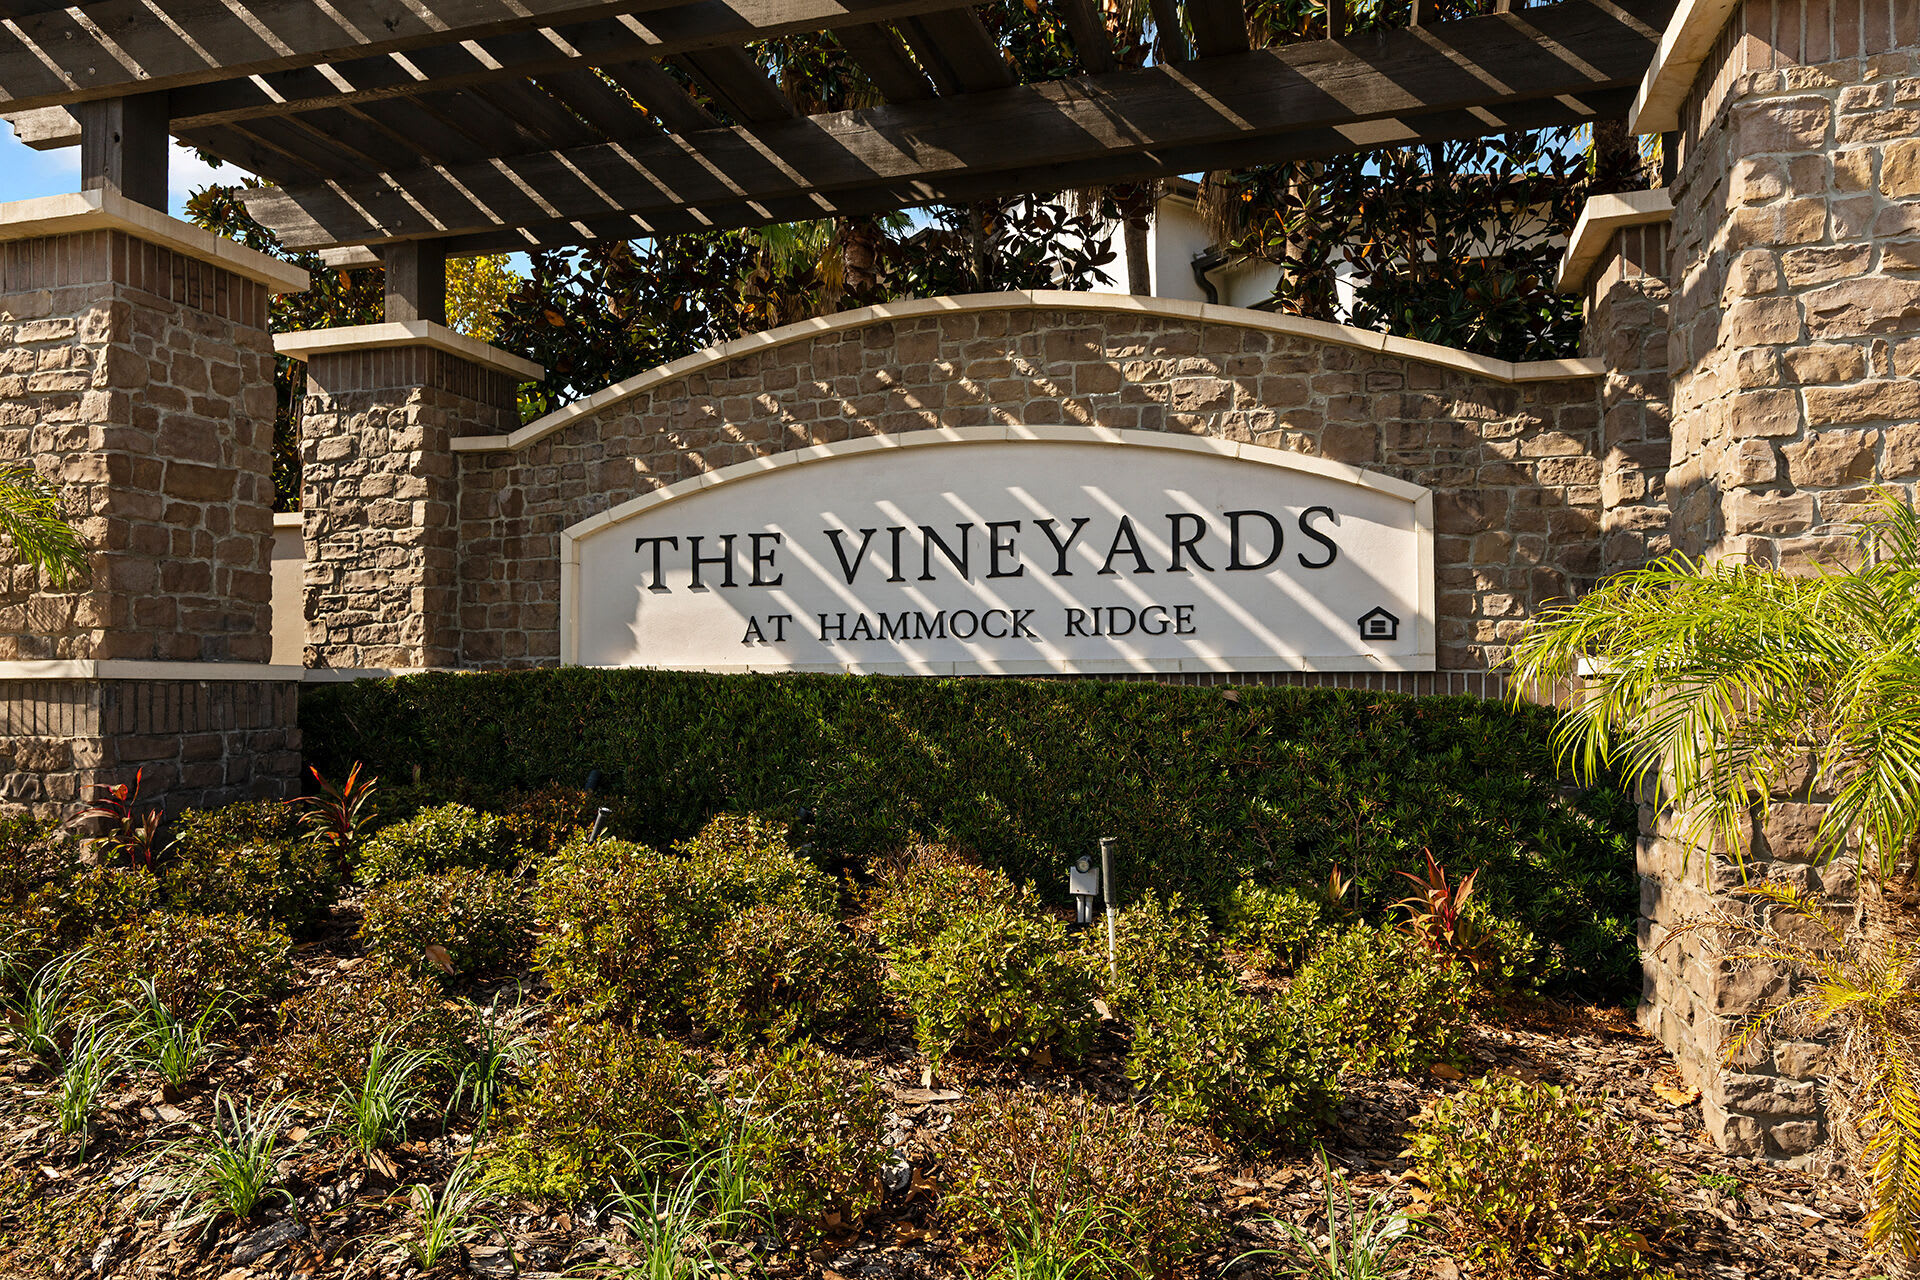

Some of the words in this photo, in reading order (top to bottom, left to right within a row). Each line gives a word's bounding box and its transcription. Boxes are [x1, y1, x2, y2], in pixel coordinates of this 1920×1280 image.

[634, 532, 784, 591] THE
[822, 505, 1338, 585] VINEYARDS
[741, 614, 793, 644] AT
[817, 609, 1037, 642] HAMMOCK
[1064, 604, 1197, 638] RIDGE
